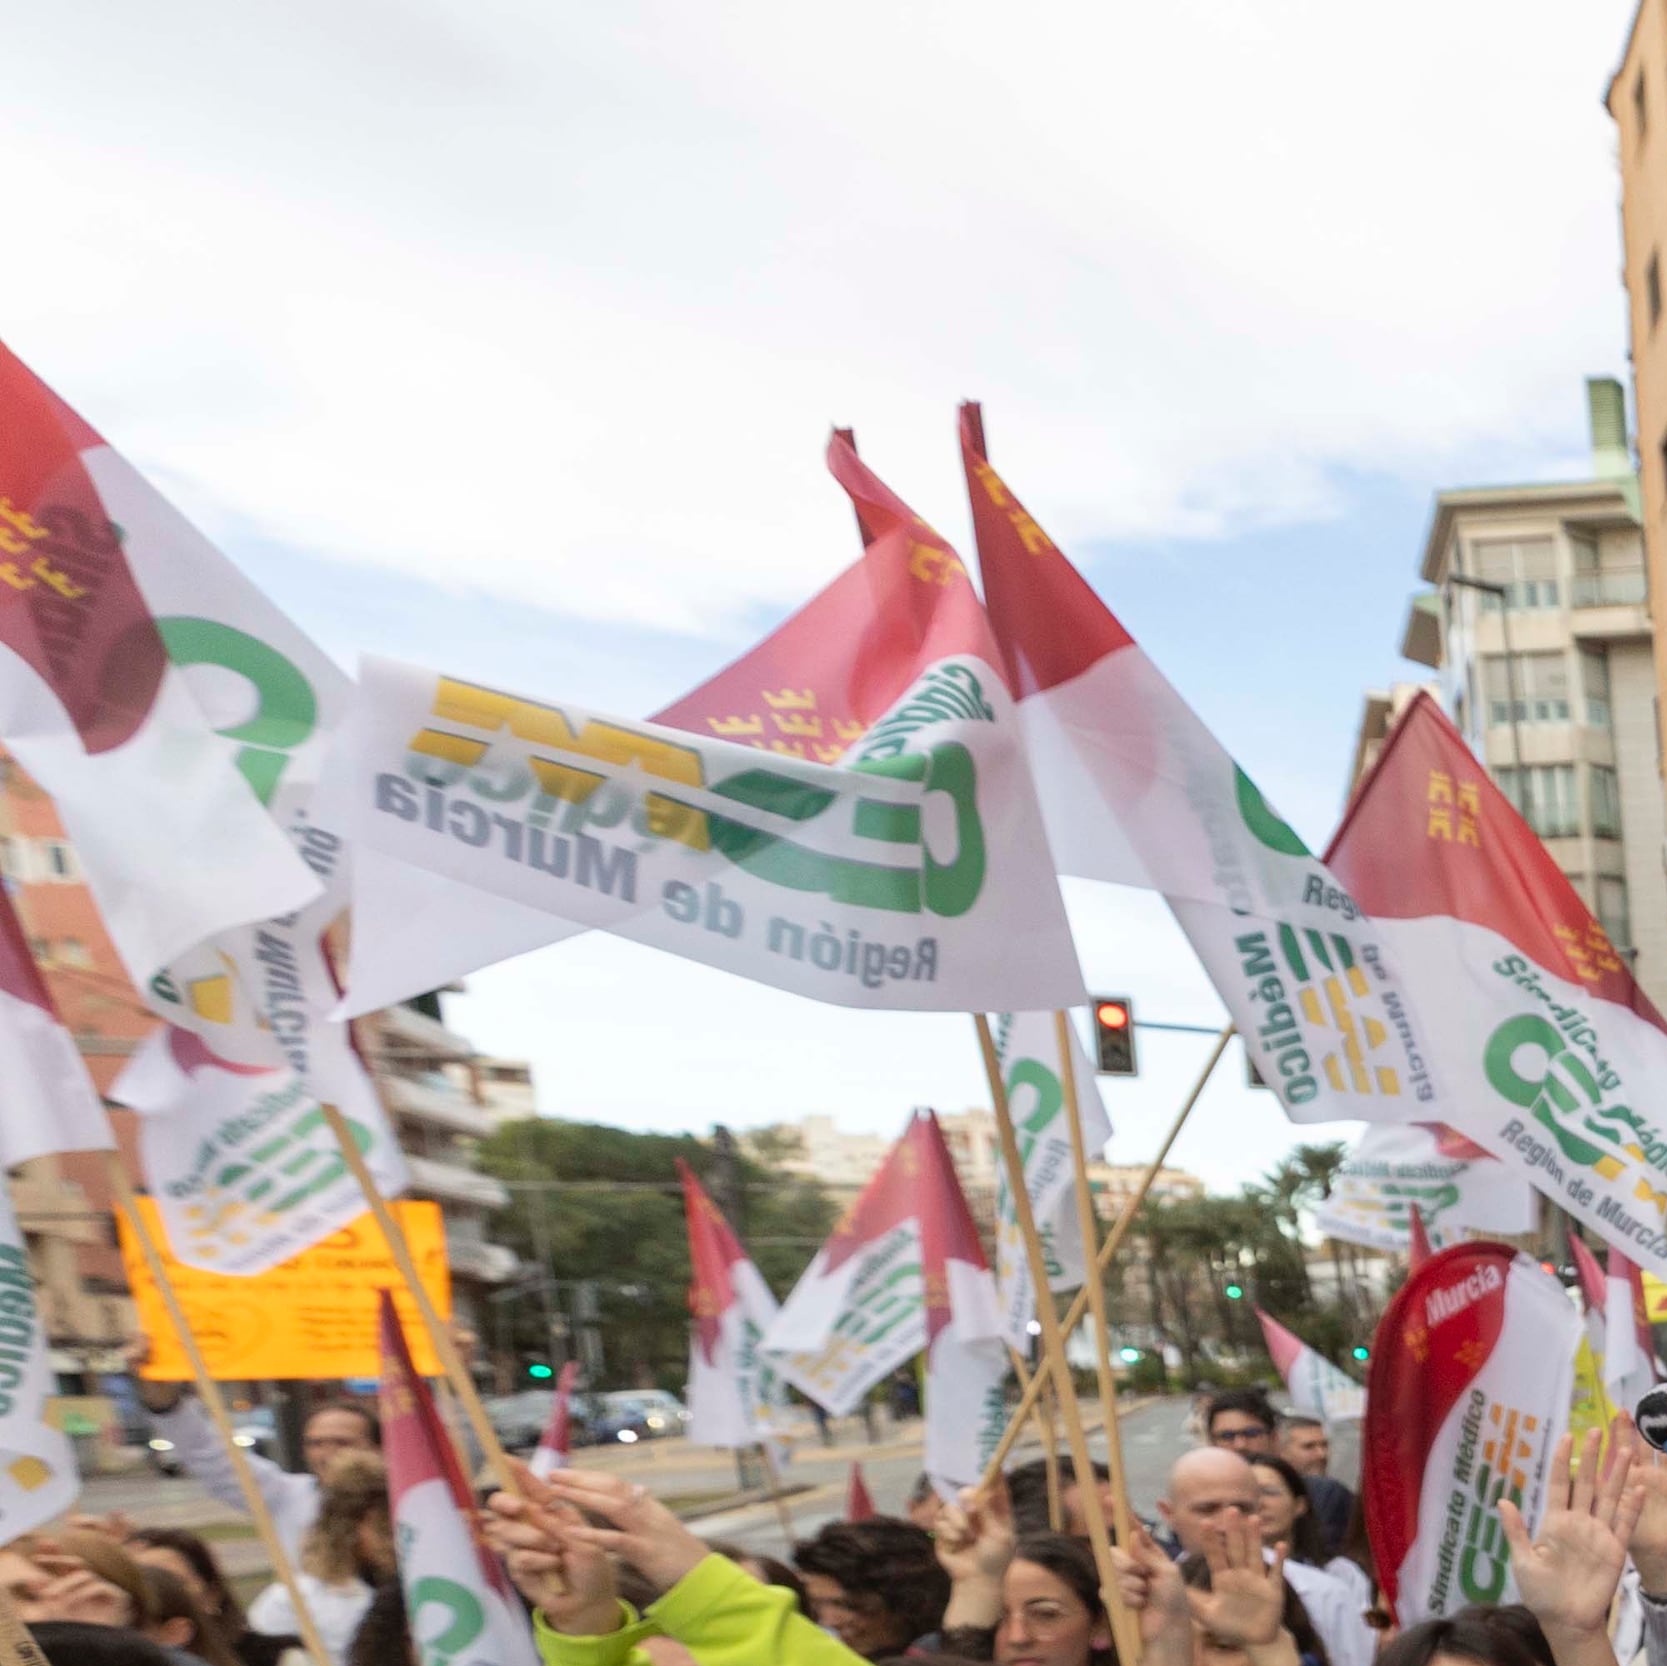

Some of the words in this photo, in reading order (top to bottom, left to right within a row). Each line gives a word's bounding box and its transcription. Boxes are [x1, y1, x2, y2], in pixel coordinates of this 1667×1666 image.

[1500, 1118, 1564, 1186] Región
[1566, 1177, 1595, 1207] de
[1425, 1263, 1503, 1328] Murcia
[1429, 1492, 1466, 1616] Sindicato
[1453, 1388, 1486, 1482] Médico
